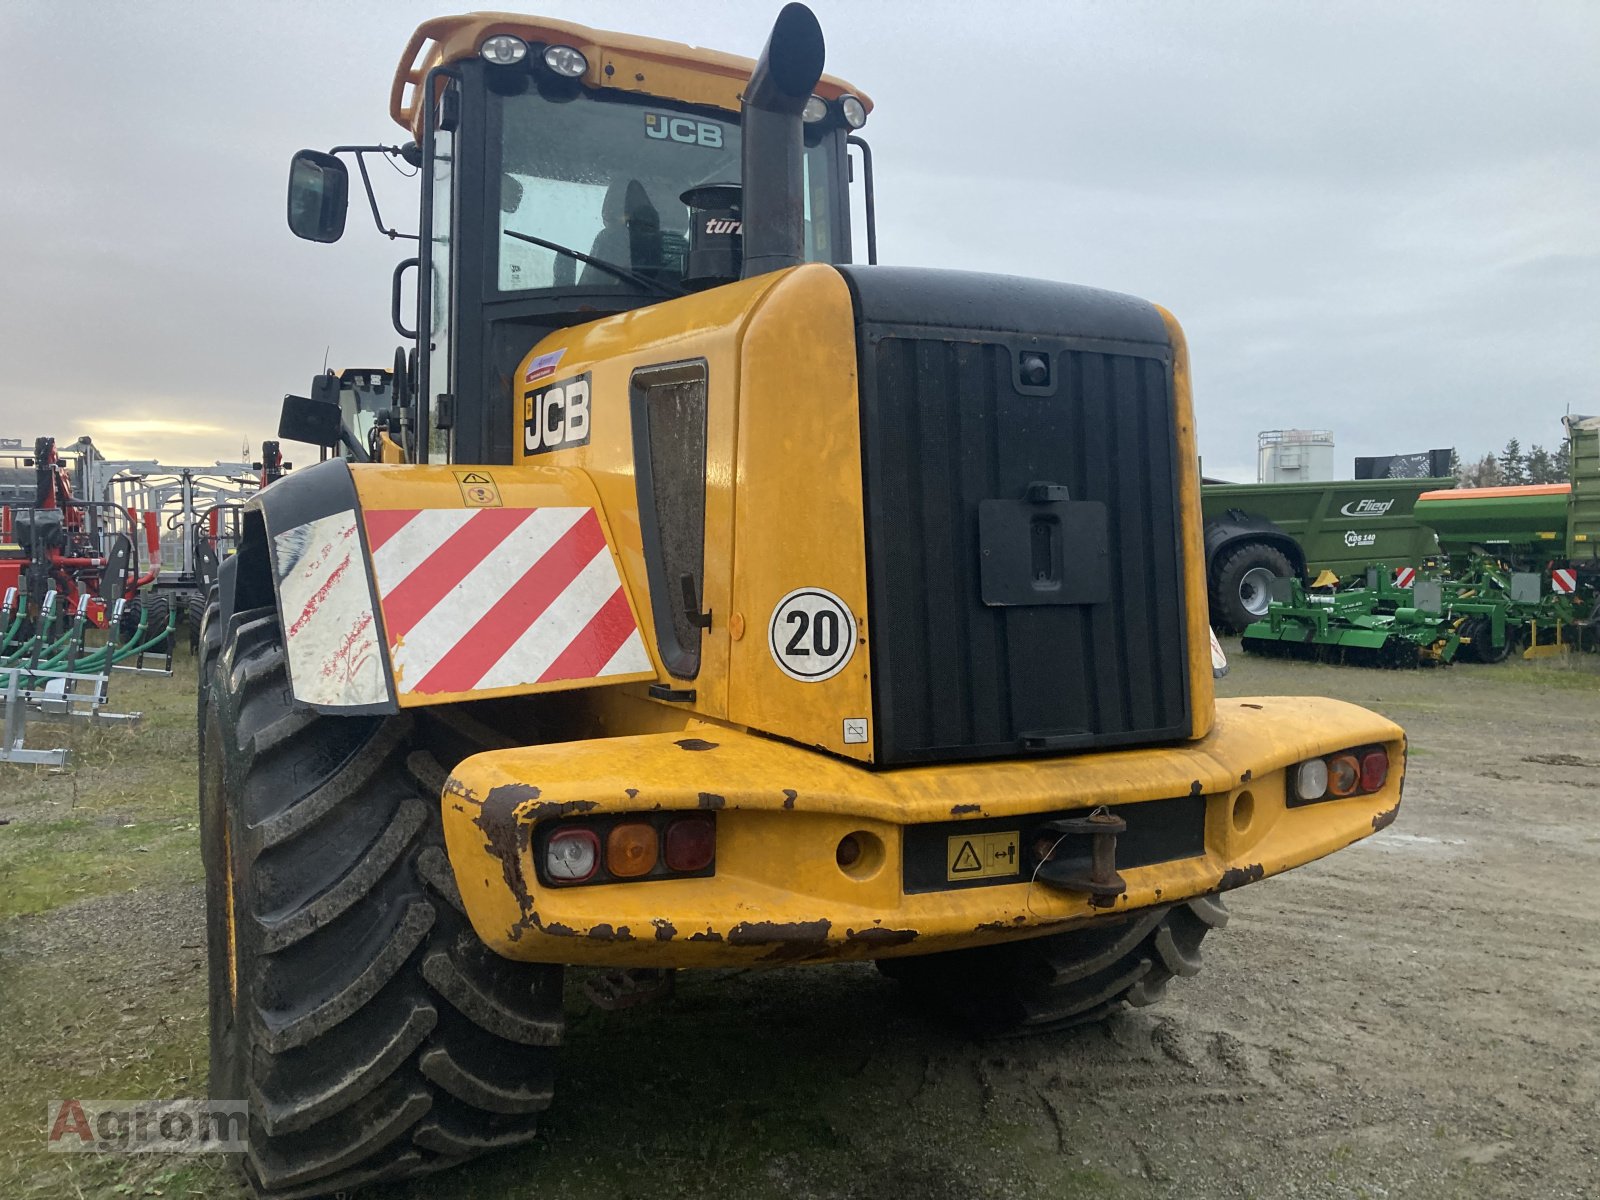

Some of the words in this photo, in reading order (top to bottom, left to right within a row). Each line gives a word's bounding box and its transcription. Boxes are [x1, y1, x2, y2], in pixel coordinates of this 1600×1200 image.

[646, 116, 723, 148] JCB
[525, 380, 589, 450] JCB
[1356, 498, 1395, 514] Fliegl
[785, 610, 839, 657] 20
